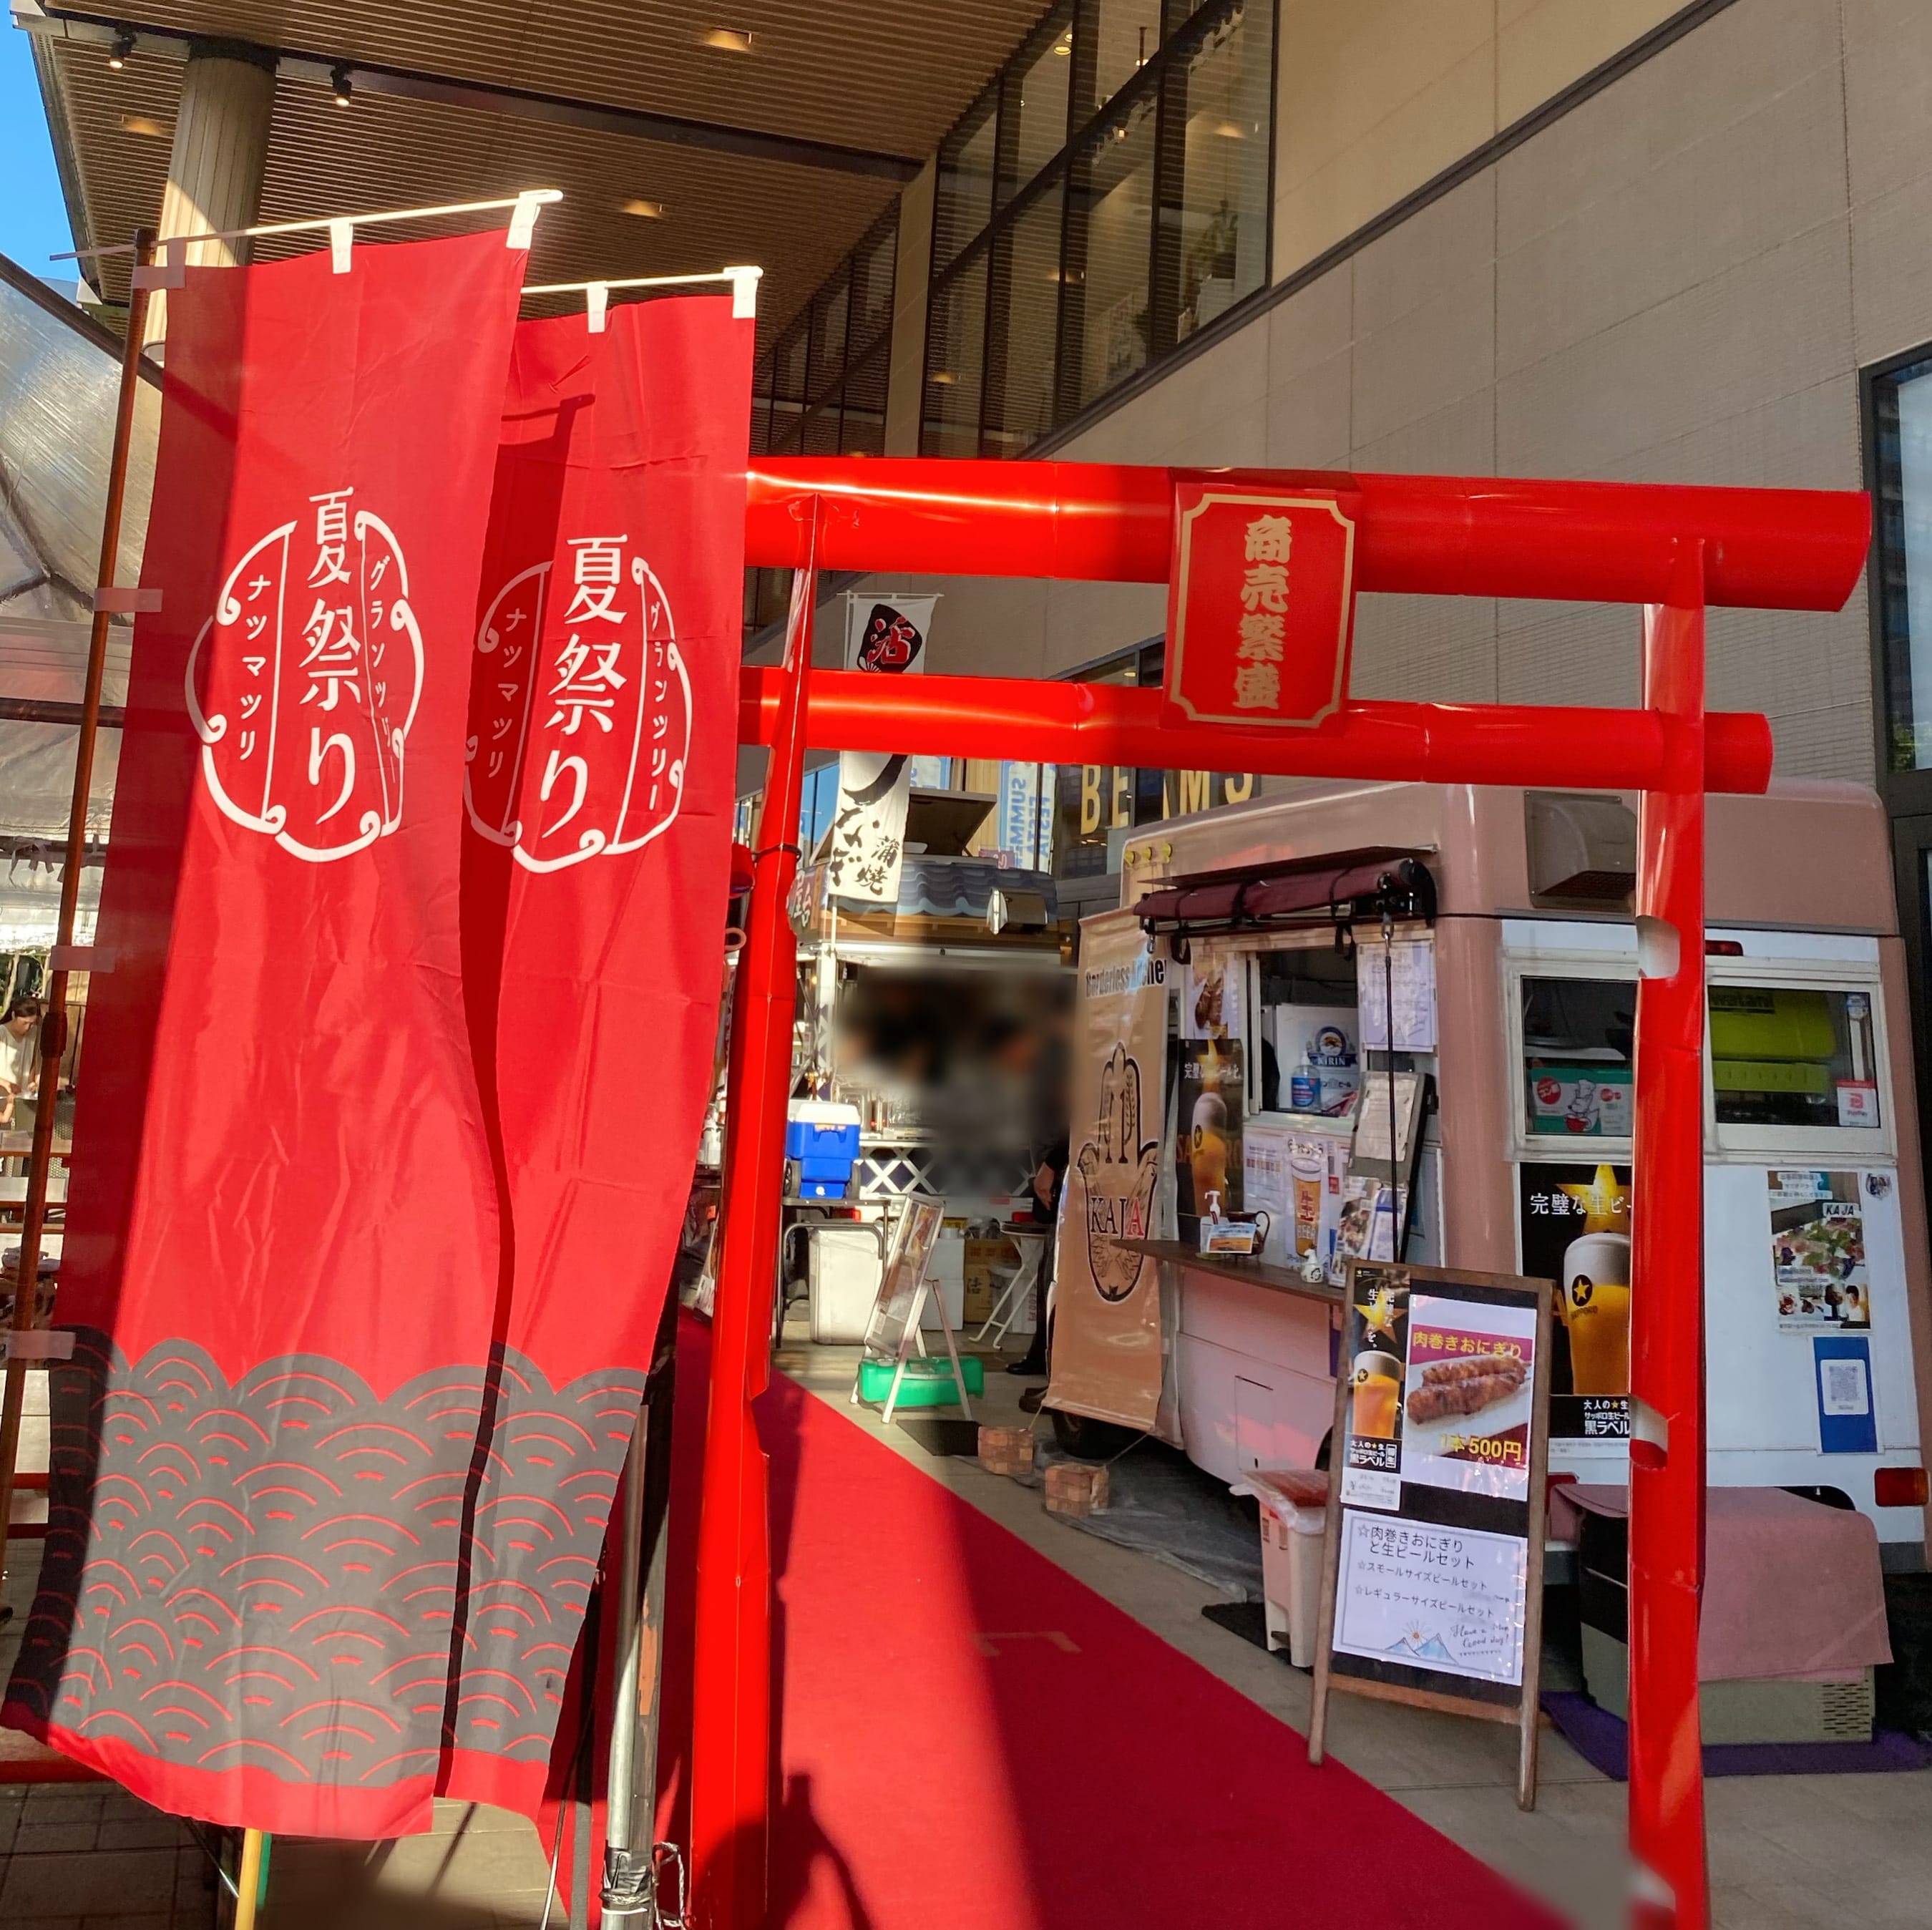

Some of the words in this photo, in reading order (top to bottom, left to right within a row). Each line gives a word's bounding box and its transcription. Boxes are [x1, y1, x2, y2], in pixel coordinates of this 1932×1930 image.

[1232, 514, 1292, 710] 商売繁盛
[240, 575, 271, 761] ナツマツリ
[298, 487, 361, 824] 夏祭り
[369, 555, 396, 784] グランツリー
[487, 608, 527, 778] ナツマツリ
[540, 534, 628, 838] 夏祭り
[647, 601, 668, 812] グランツリー
[1317, 1056, 1346, 1066] KIRIN
[1091, 1196, 1145, 1239] KAJA
[1826, 1205, 1855, 1217] KAJA
[1413, 1330, 1522, 1360] 肉巻きおにぎり
[1584, 1411, 1631, 1420] サッポロ生ビール
[1584, 1420, 1631, 1435] 黒ラベル
[1441, 1433, 1465, 1453] 1本
[1468, 1436, 1522, 1463] 500円
[1370, 1526, 1463, 1553] 肉巻きおにぎり
[1370, 1541, 1475, 1569] と生ビールセット
[1367, 1562, 1488, 1591] スモールサイズビールセット
[1365, 1587, 1494, 1618] レギュラーサイズビールセット
